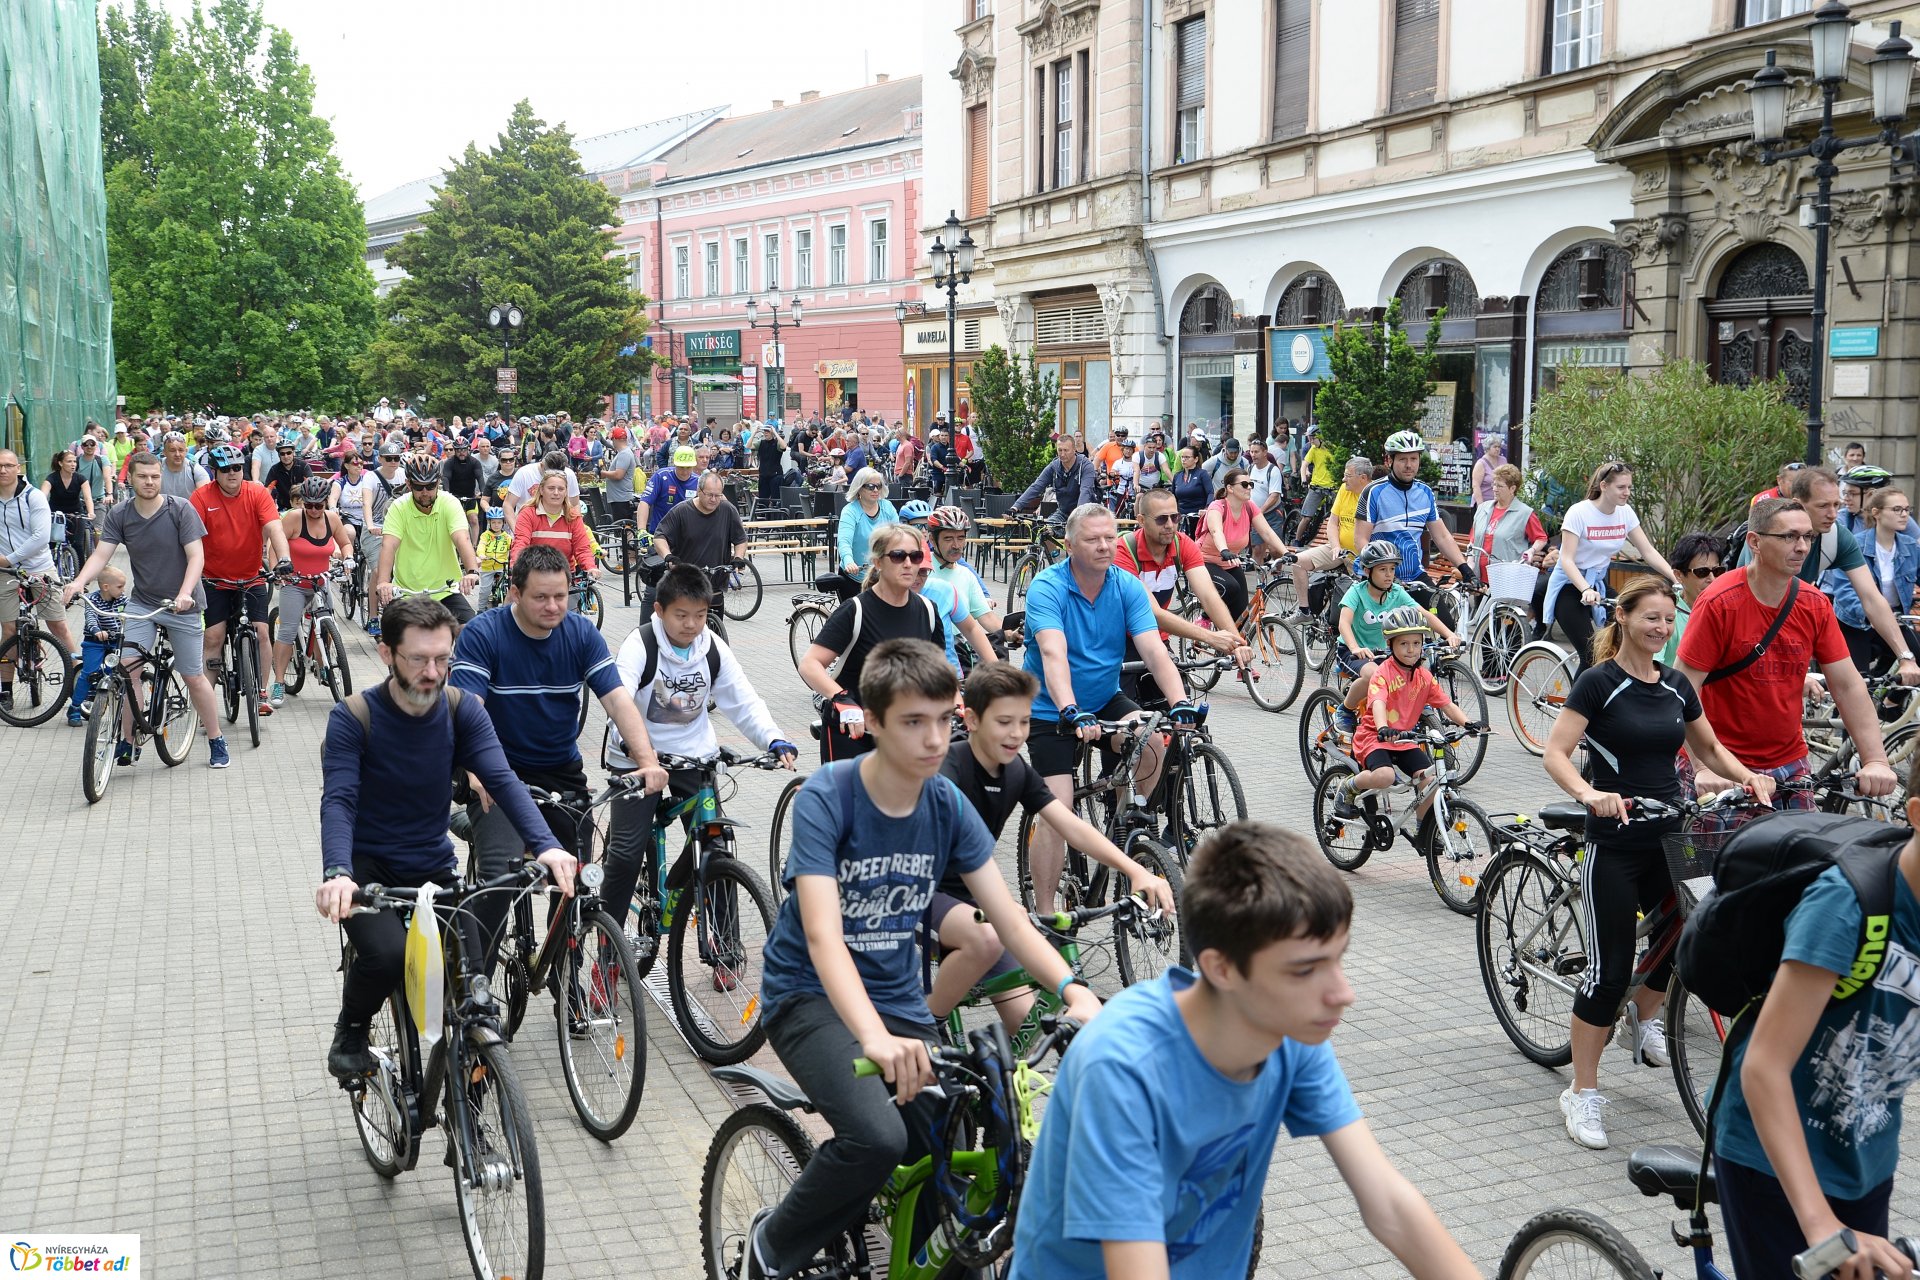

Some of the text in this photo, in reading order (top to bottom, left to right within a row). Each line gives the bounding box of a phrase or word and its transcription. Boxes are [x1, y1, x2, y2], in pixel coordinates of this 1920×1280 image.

[690, 332, 733, 350] NYÍRSÉG
[1589, 528, 1625, 537] NEVERMIND
[837, 856, 891, 883] SPEED
[890, 853, 935, 879] REBEL
[839, 887, 890, 930] acing
[856, 931, 890, 942] AMERICAN
[865, 940, 899, 952] STANDARD
